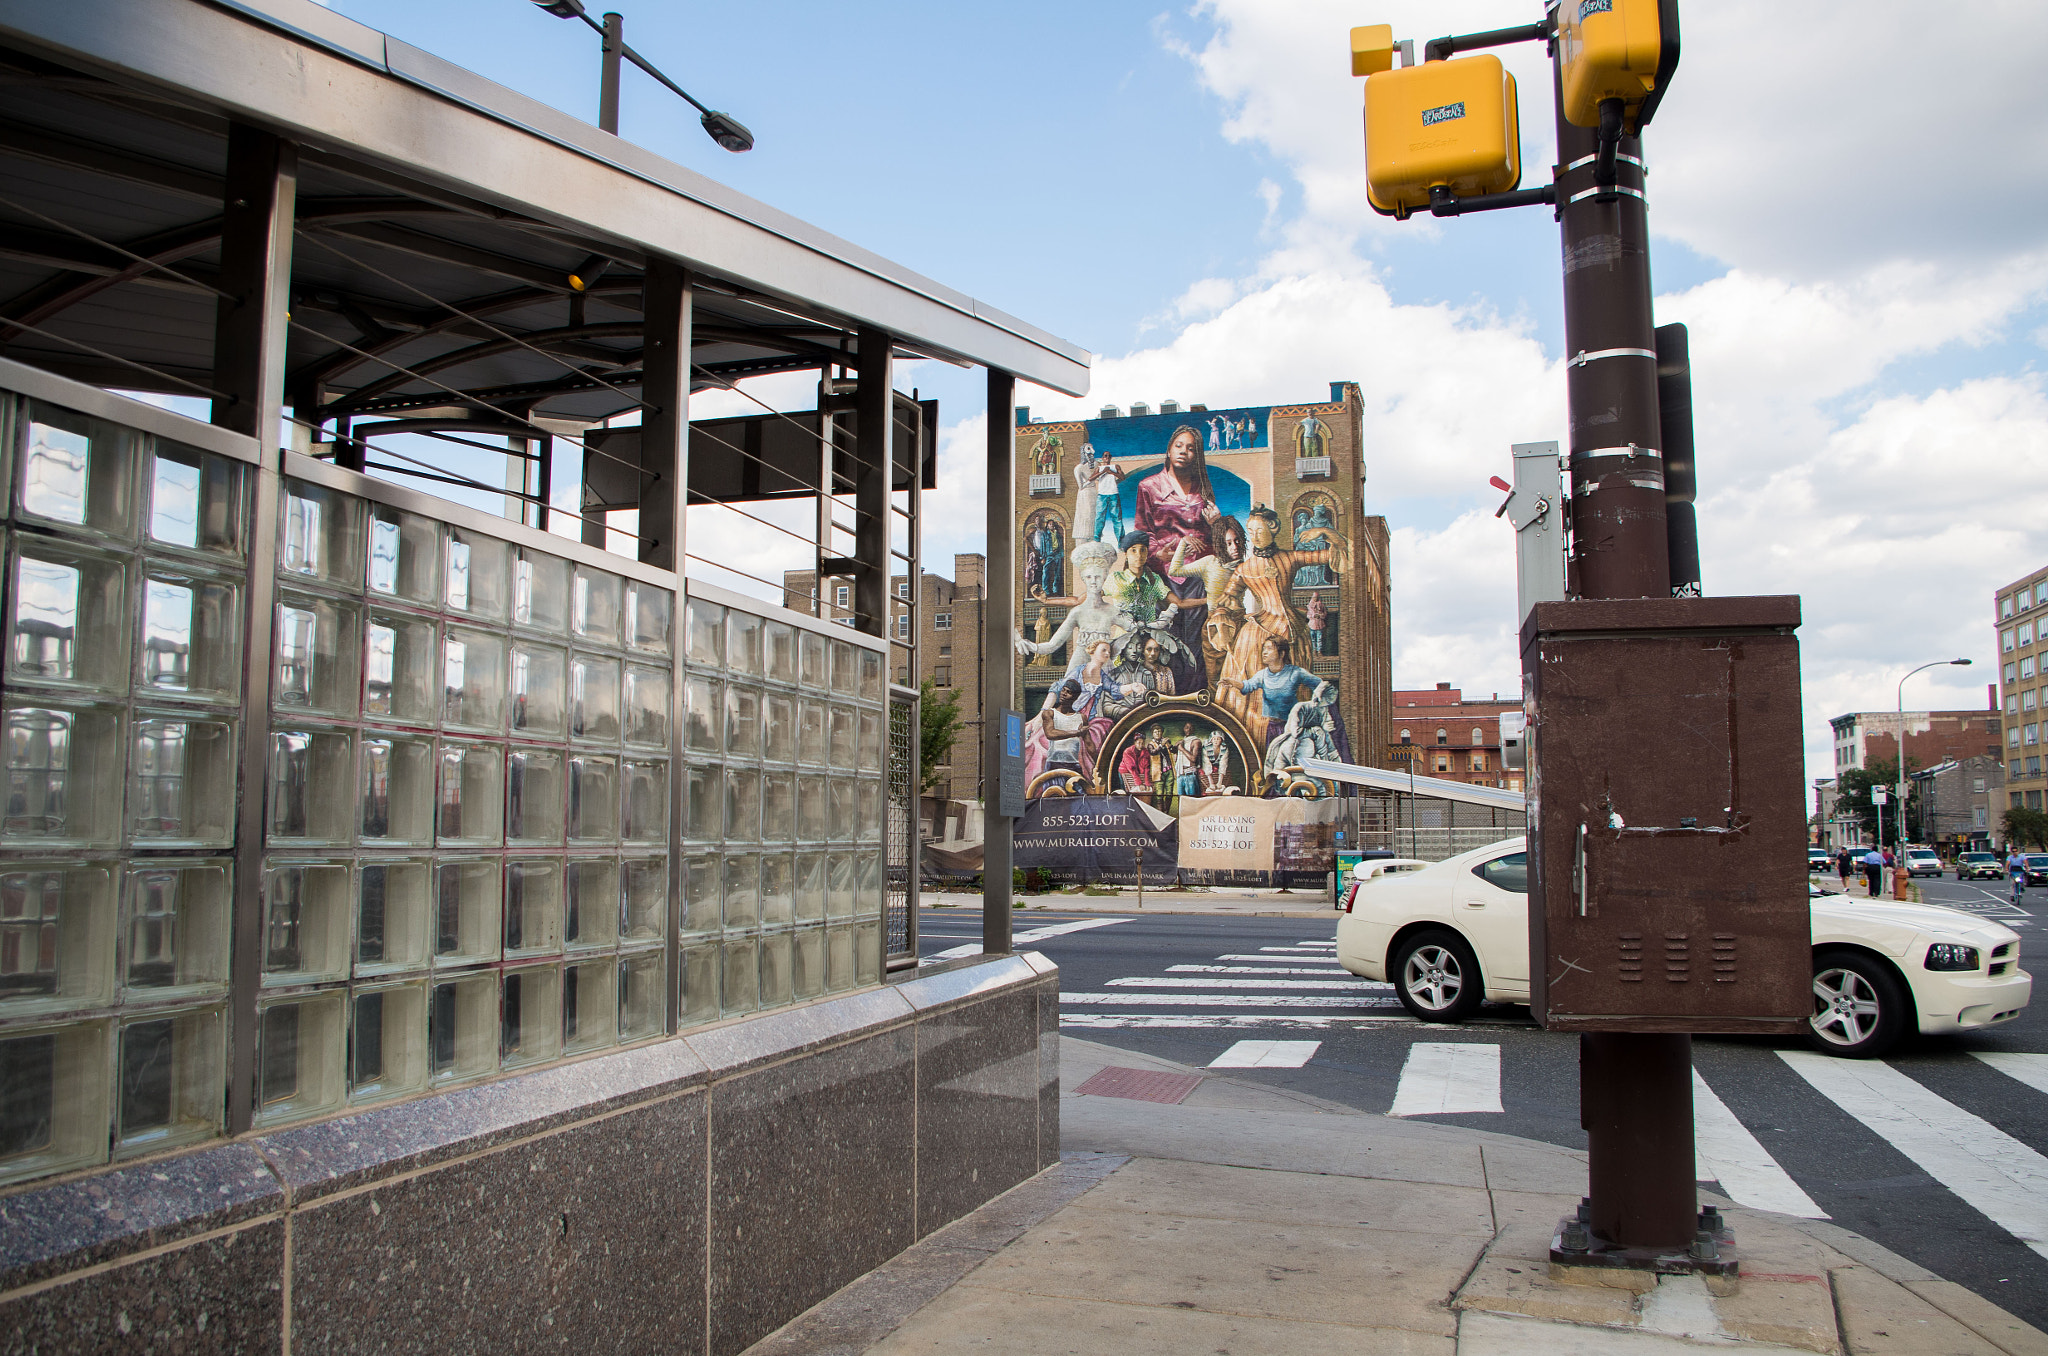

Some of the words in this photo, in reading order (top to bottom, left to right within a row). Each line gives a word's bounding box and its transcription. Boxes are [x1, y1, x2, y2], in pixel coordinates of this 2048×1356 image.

[1042, 815, 1129, 826] 855-523-LOFT
[1201, 816, 1216, 824] OR
[1218, 815, 1256, 825] LEASING
[1202, 824, 1226, 833] INFO
[1228, 825, 1250, 833] CALL
[1013, 838, 1158, 849] WWW.MURALLOFTS.COM
[1189, 839, 1255, 849] 855-523-LOF
